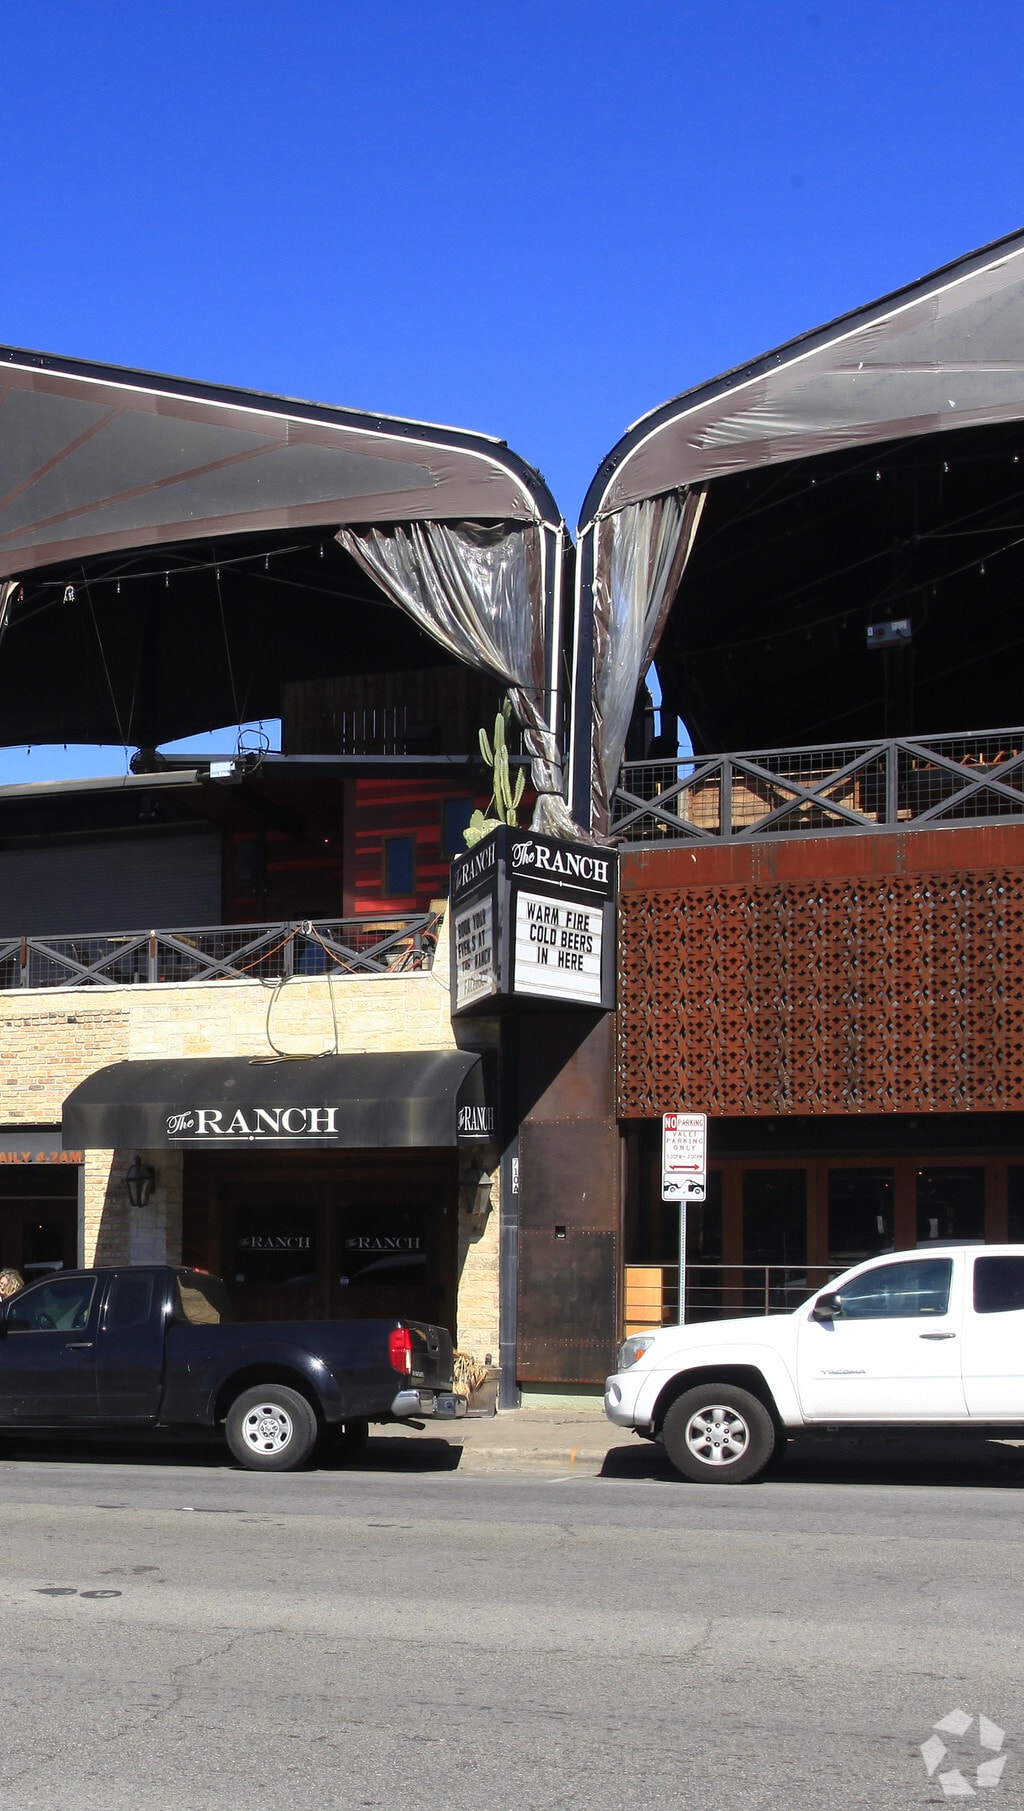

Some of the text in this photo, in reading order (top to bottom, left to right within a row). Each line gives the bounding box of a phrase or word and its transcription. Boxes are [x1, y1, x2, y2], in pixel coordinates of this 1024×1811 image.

[461, 841, 496, 887] RANCH
[512, 840, 609, 883] The RANCH
[527, 902, 590, 932] WARM FIRE
[529, 923, 593, 953] COLD BEERS
[537, 946, 584, 971] IN HERE
[166, 1107, 339, 1134] The RANCH
[464, 1106, 494, 1131] RANCH
[665, 1116, 704, 1129] NO PARKING
[36, 1151, 83, 1163] 4-2AM
[251, 1236, 311, 1248] RANCH
[358, 1236, 421, 1249] RANCH
